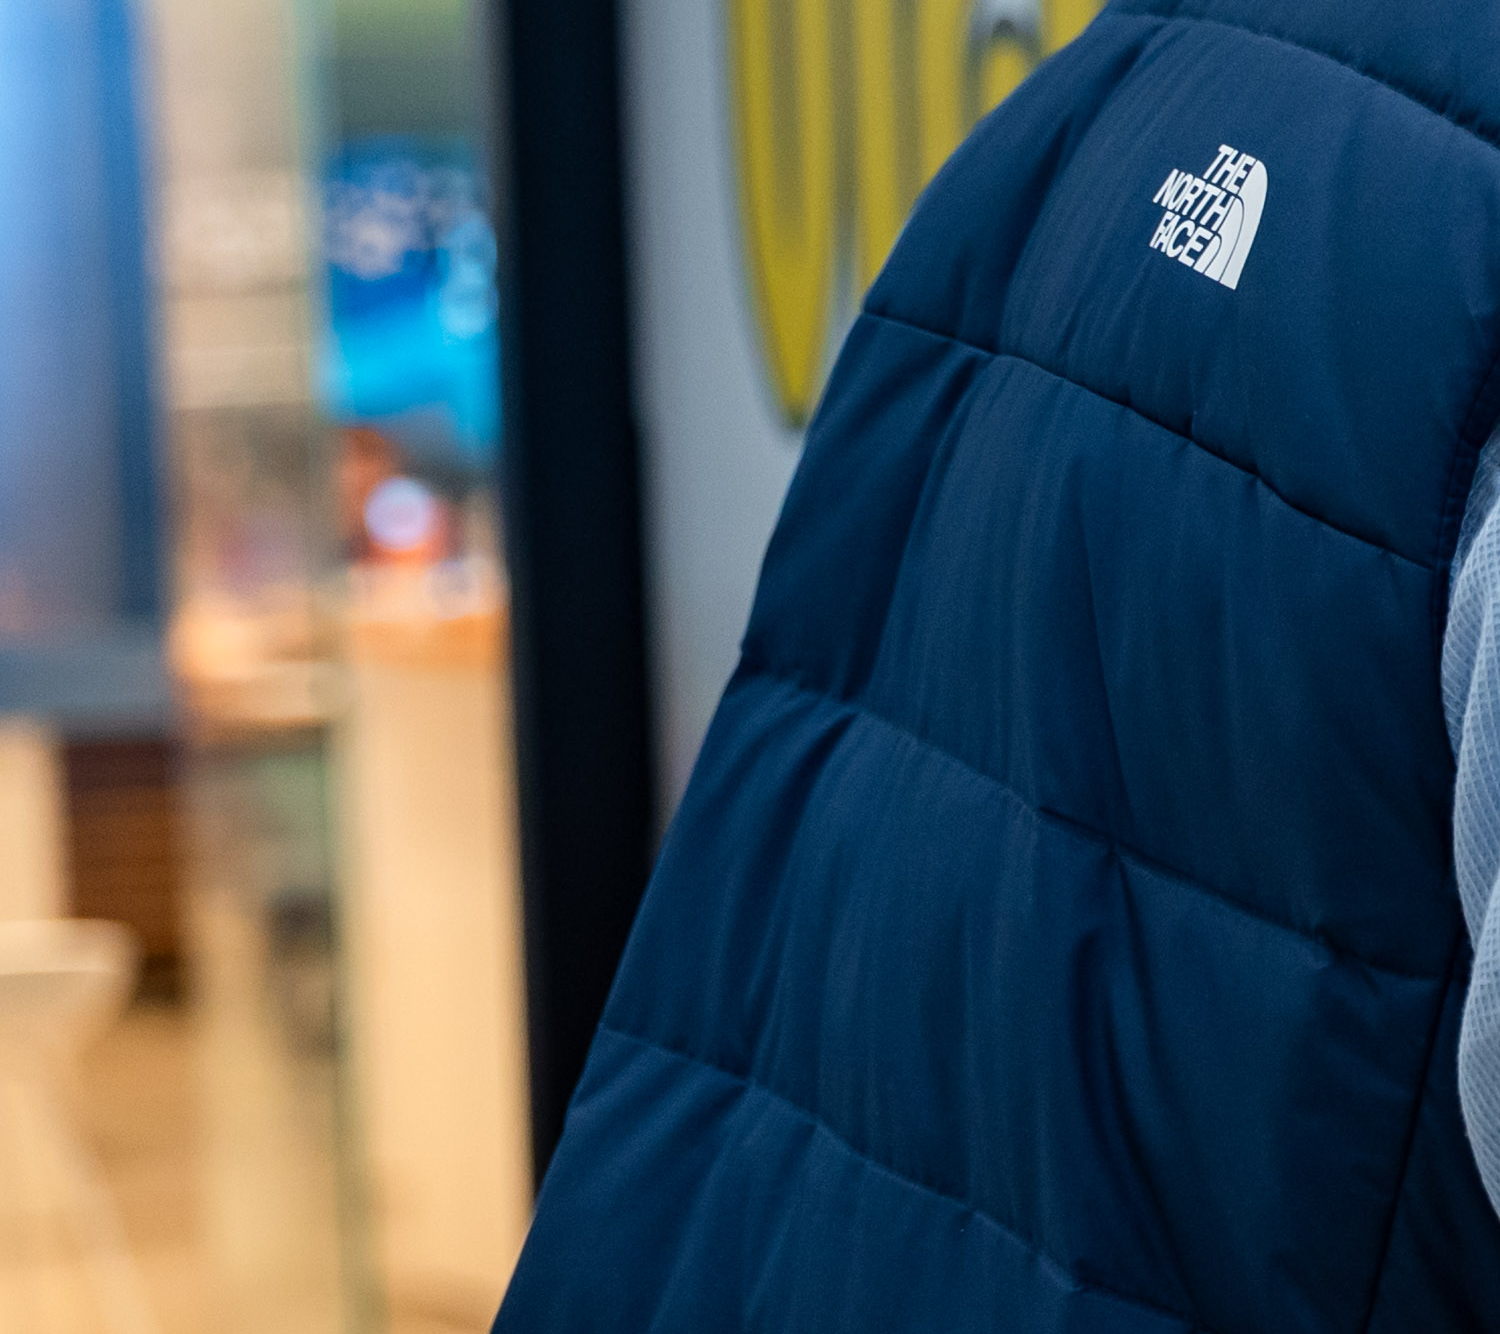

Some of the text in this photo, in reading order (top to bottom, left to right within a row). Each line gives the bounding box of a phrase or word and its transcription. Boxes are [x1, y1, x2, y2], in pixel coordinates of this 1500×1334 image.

[1203, 143, 1257, 196] THE
[1152, 167, 1236, 233] NORTH
[1148, 210, 1216, 268] FACE
